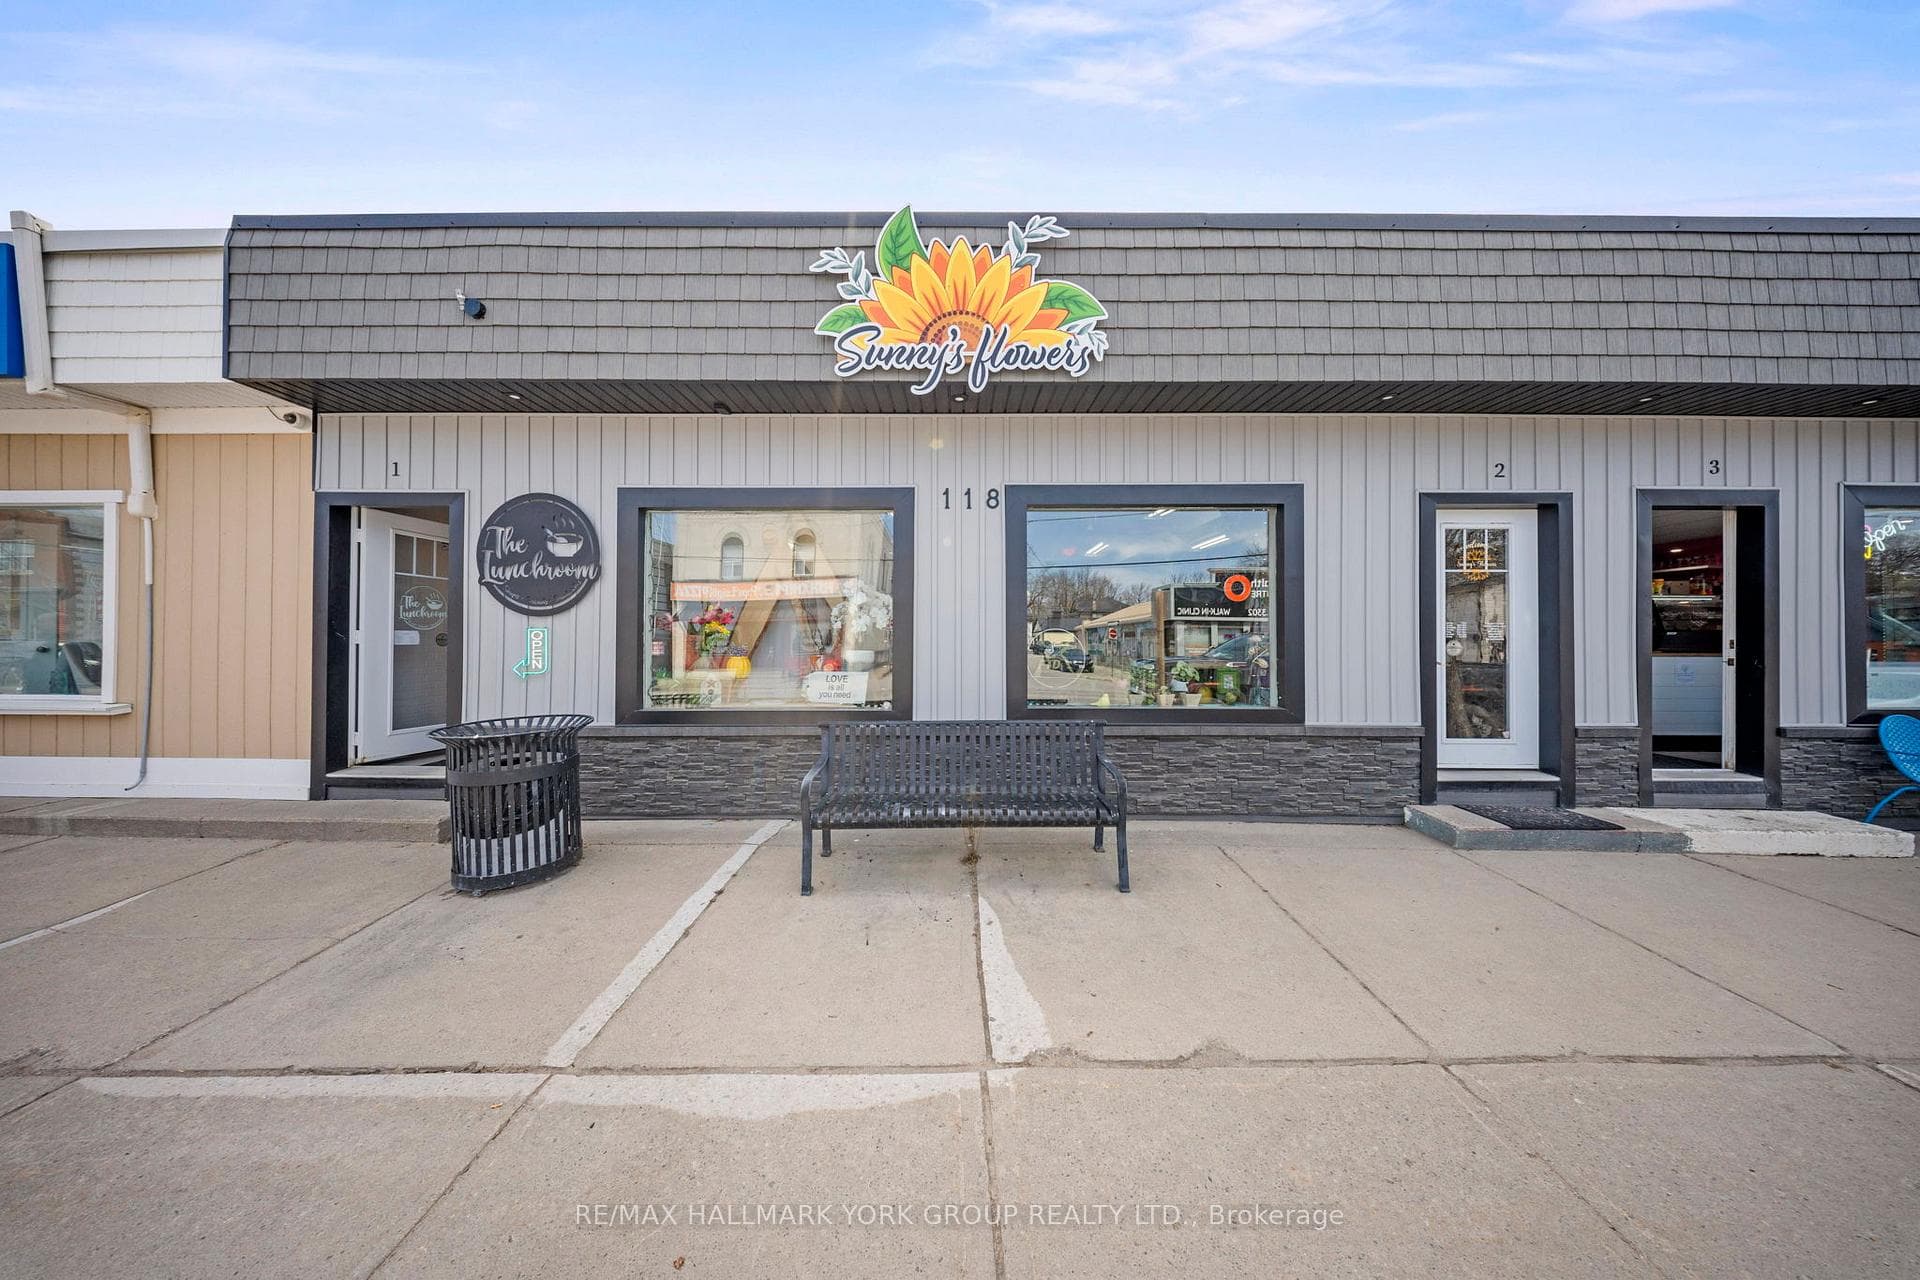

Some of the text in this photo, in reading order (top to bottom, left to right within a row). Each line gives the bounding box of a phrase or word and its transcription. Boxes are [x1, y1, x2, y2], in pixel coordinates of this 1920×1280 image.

[836, 325, 1090, 392] Sunny's flowers
[392, 461, 400, 476] 1
[1494, 462, 1505, 478] 2
[1709, 459, 1719, 475] 3
[943, 488, 999, 509] 118
[484, 526, 528, 559] The
[481, 550, 598, 584] Lunchroom
[401, 594, 420, 609] The
[531, 630, 543, 669] OPEN
[825, 674, 848, 683] LOVE
[818, 691, 832, 699] you
